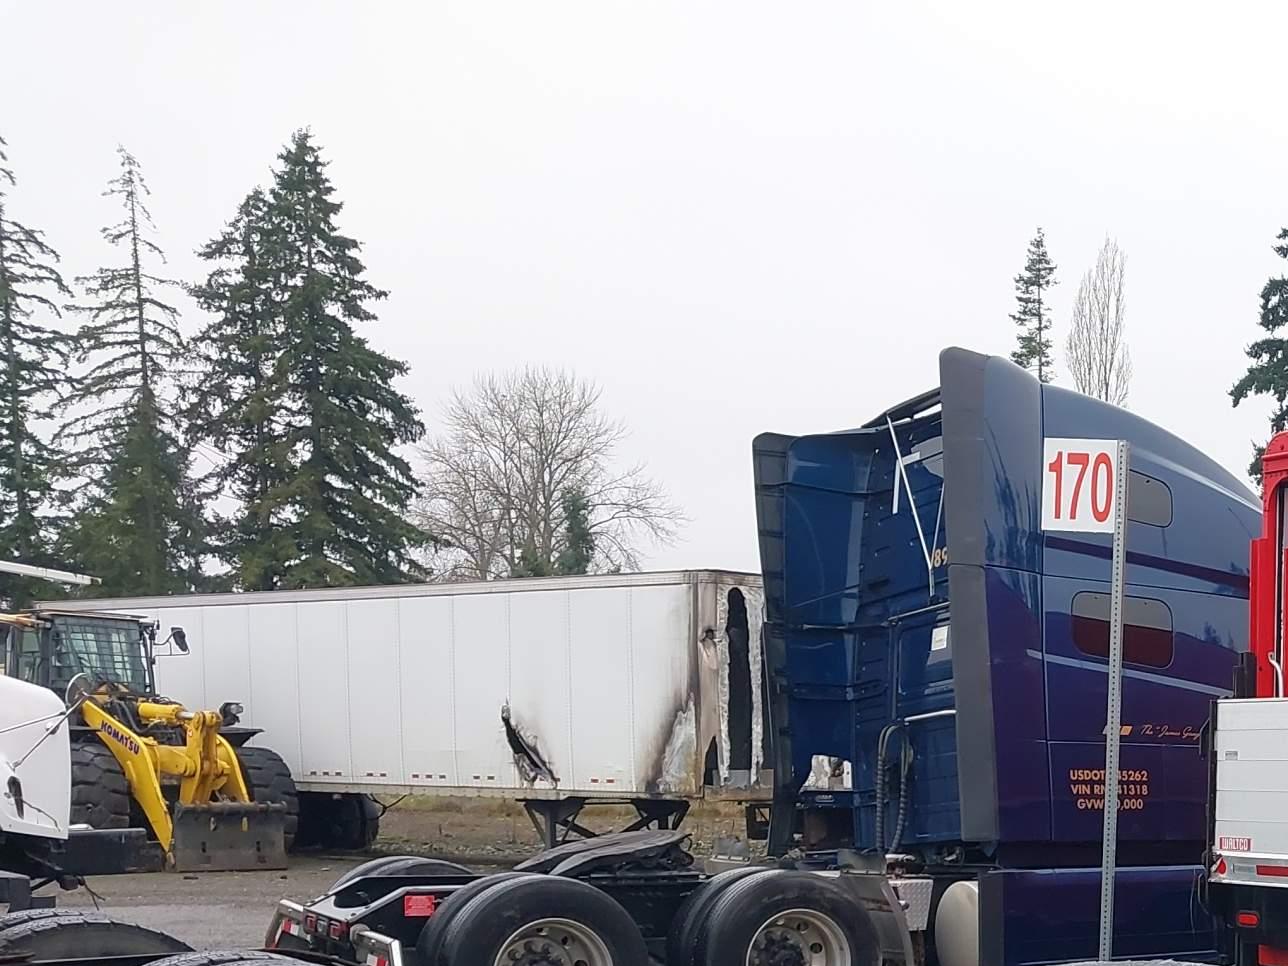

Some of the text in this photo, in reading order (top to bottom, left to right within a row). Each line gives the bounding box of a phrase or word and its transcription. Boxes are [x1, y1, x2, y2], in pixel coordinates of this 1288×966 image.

[1048, 450, 1114, 523] 170
[100, 719, 140, 755] KOMATSU
[1070, 784, 1091, 795] VIN
[1221, 837, 1248, 850] WALTCO
